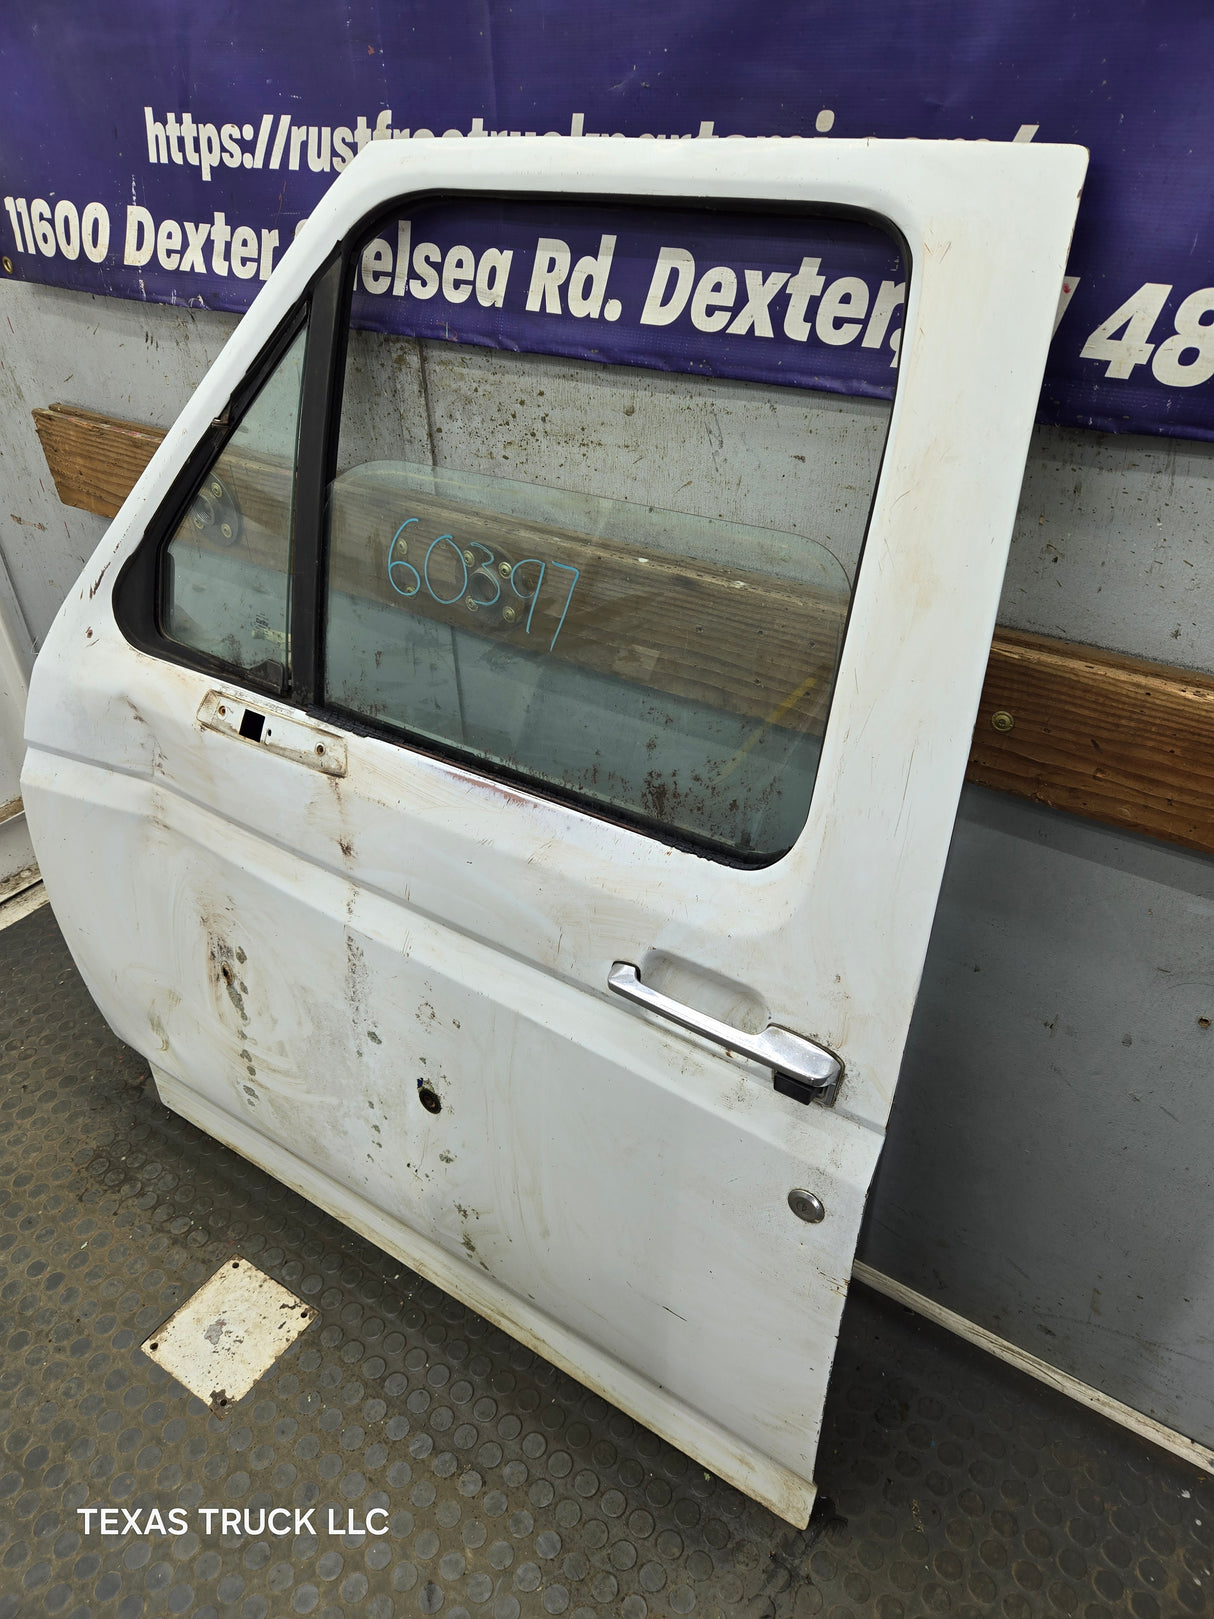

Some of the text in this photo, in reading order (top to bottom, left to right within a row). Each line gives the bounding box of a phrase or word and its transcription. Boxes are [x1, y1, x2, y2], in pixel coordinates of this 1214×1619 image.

[4, 196, 110, 263] 11600
[124, 205, 280, 281] Dexter
[294, 218, 513, 307] elsea
[525, 234, 622, 322] Rd.
[388, 518, 580, 652] 60397
